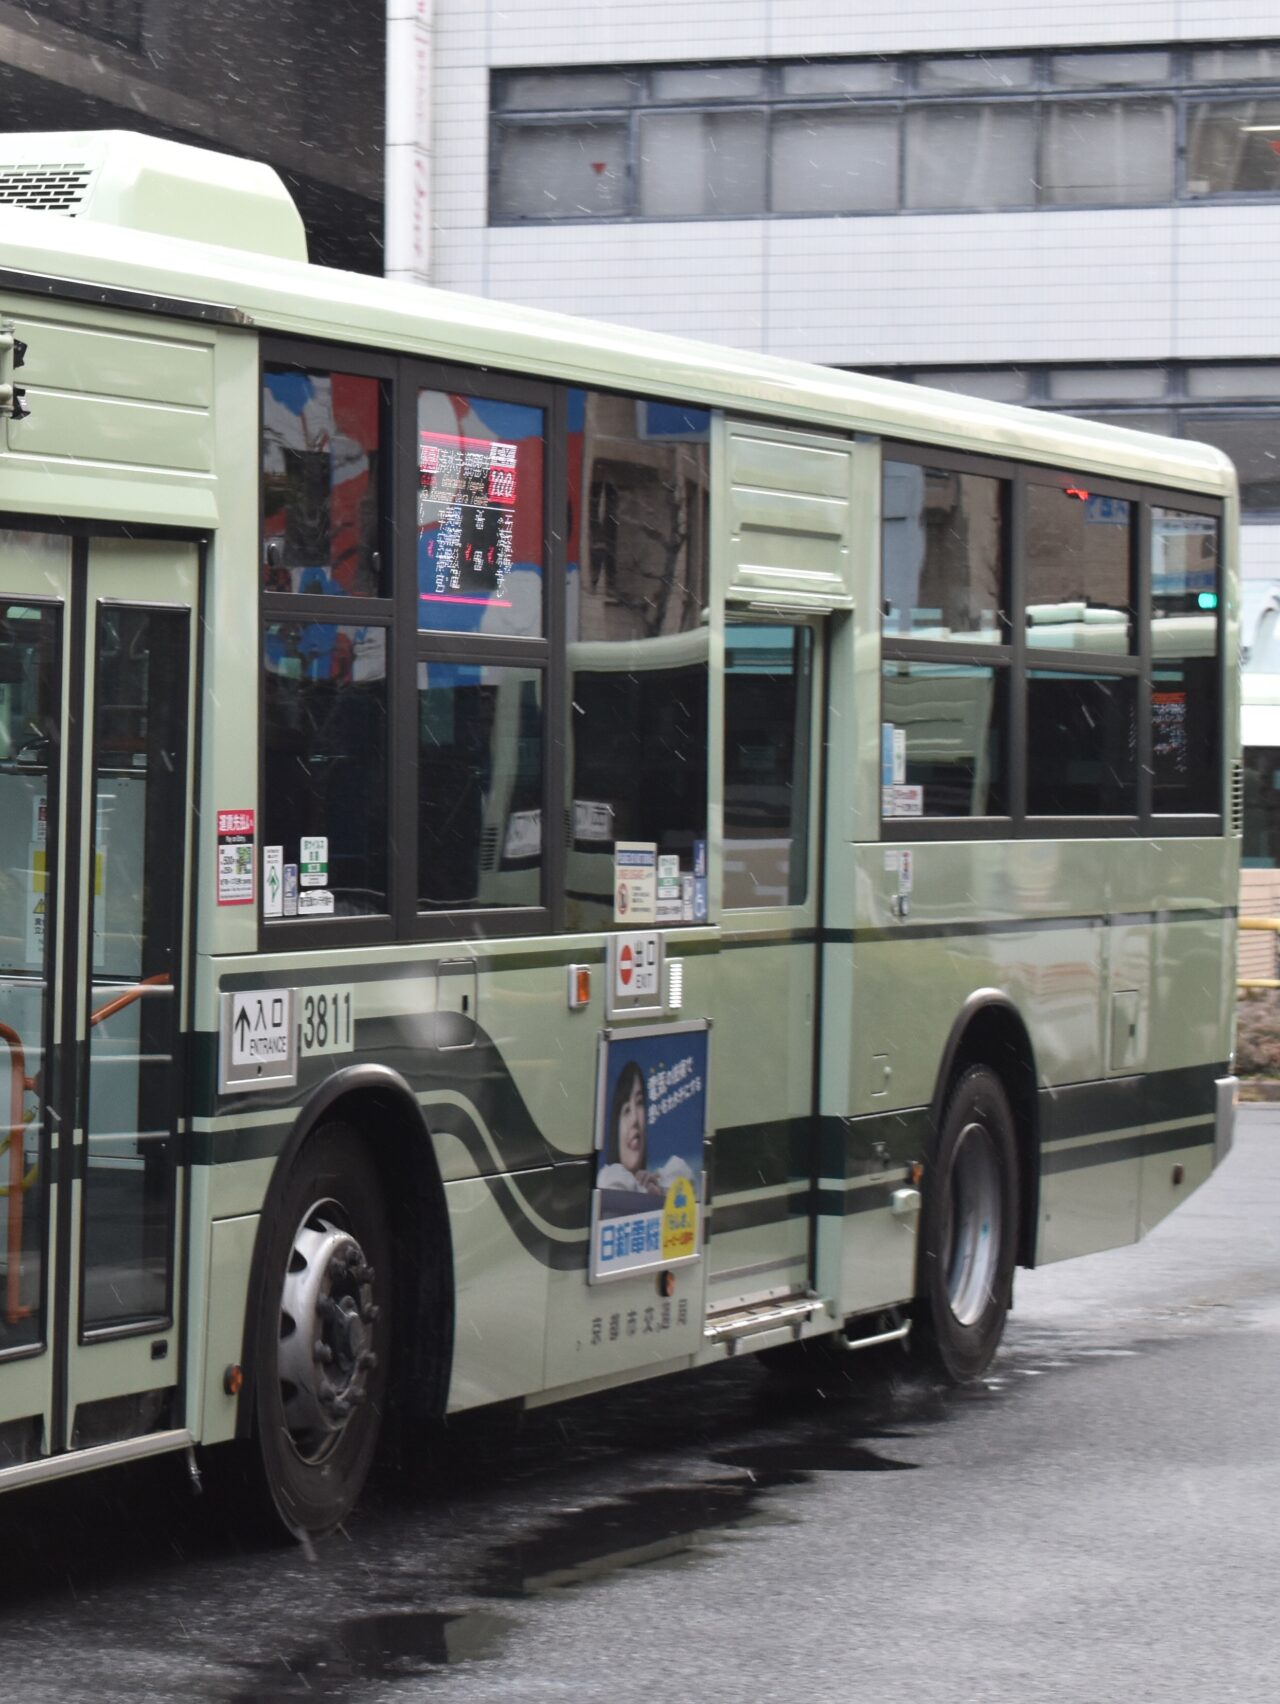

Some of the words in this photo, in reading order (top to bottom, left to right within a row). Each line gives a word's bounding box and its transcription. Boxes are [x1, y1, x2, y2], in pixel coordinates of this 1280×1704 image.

[634, 940, 655, 968] 出口
[635, 972, 653, 989] EXIT
[254, 998, 283, 1031] 入口
[303, 992, 351, 1049] 3811
[249, 1036, 287, 1056] ENTRANCE
